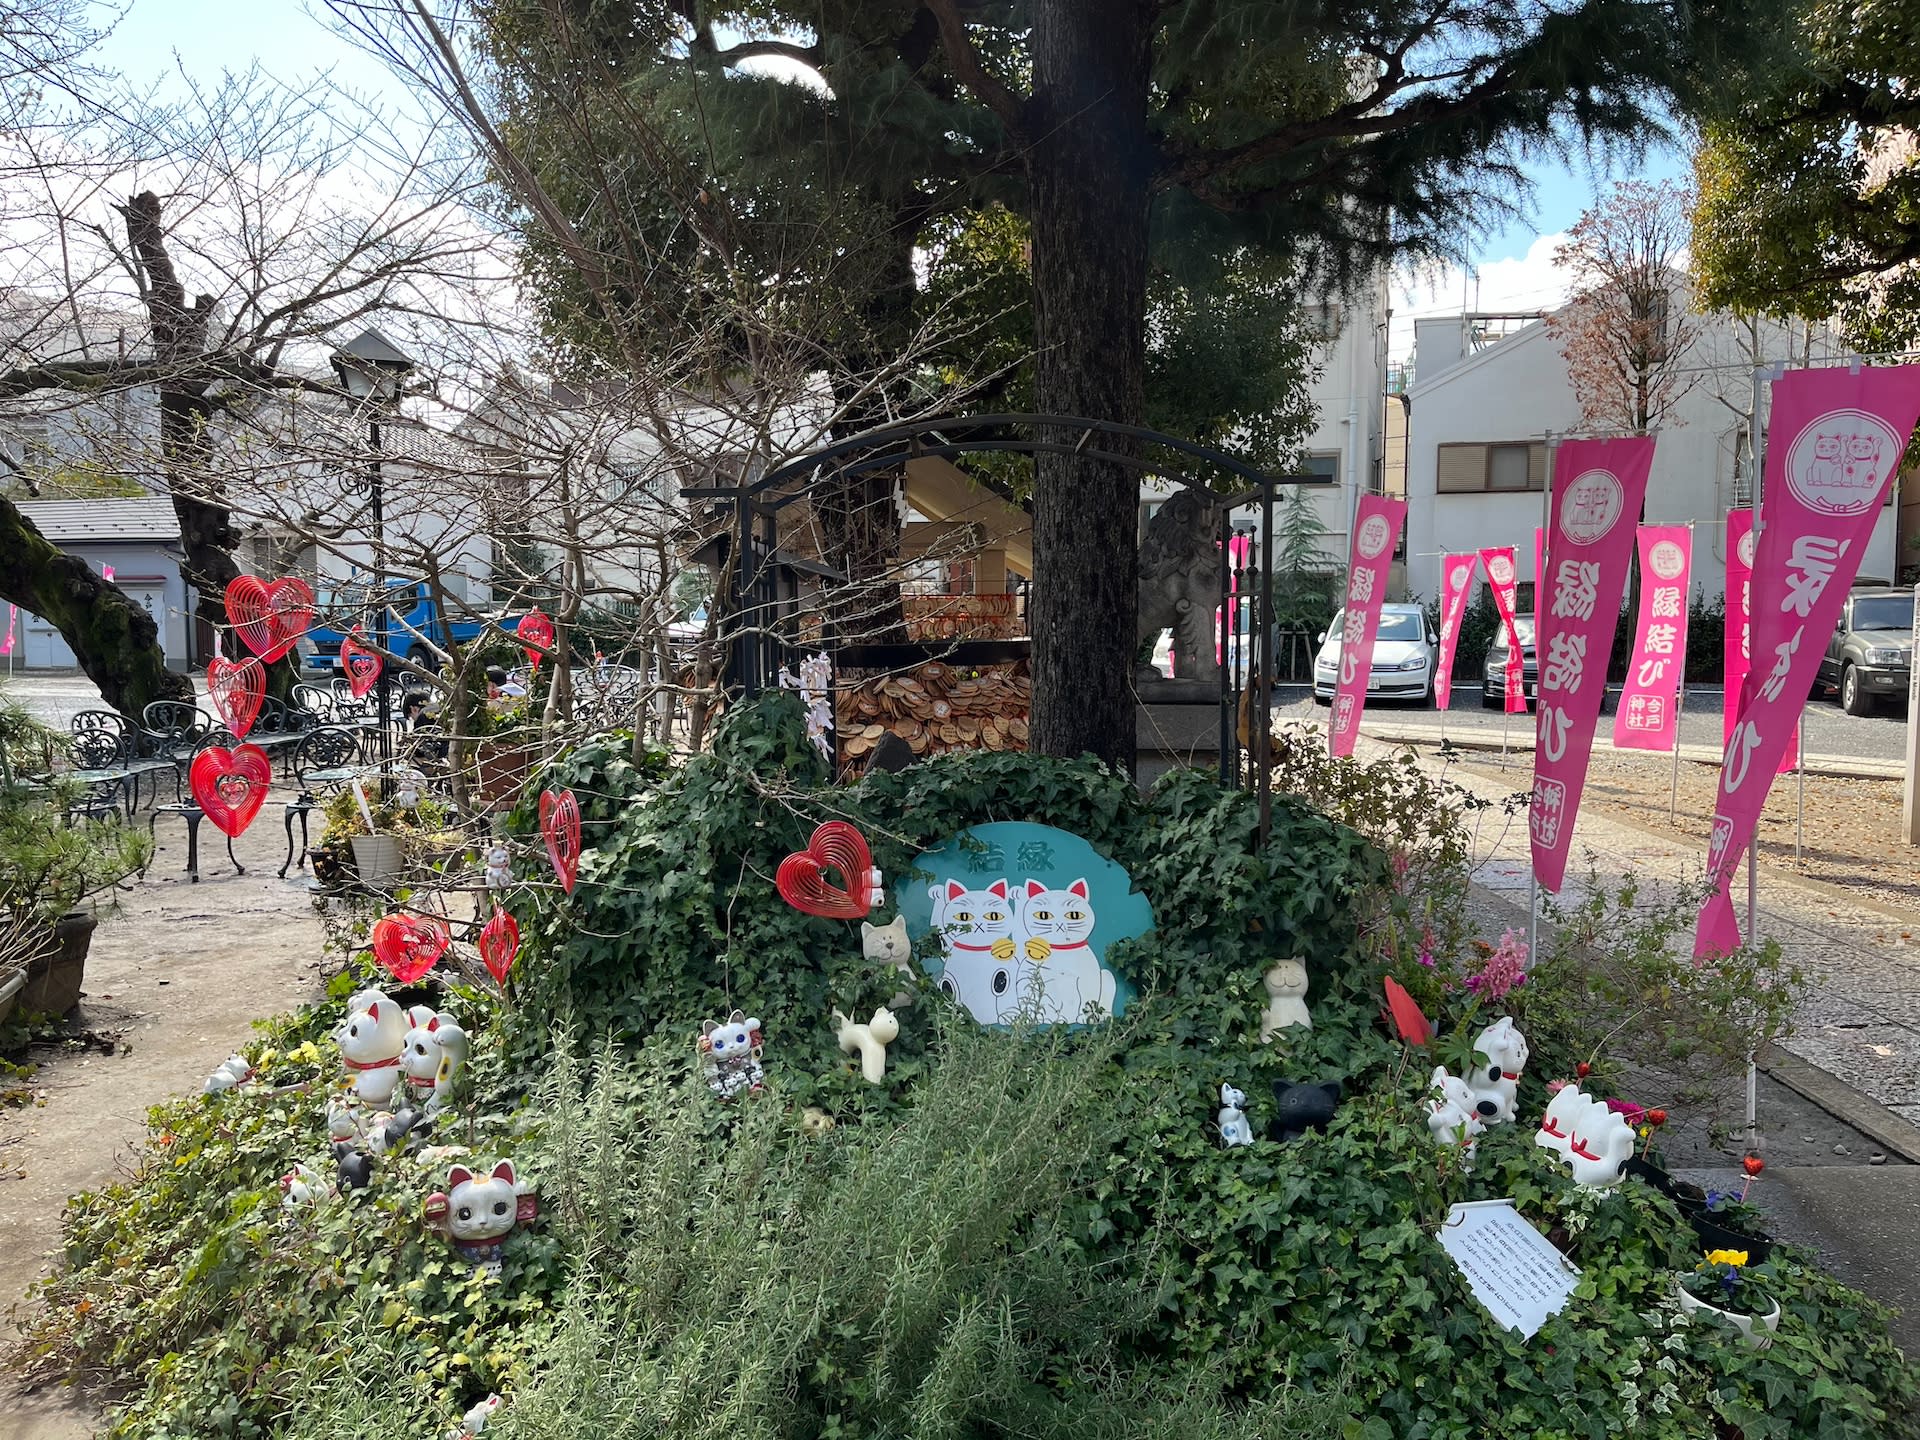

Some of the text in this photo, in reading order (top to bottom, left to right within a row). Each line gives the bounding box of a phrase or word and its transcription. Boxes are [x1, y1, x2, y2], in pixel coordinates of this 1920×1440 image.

[1637, 586, 1681, 688] 縁結び
[1628, 697, 1646, 728] 神社
[1645, 698, 1663, 728] 今戸
